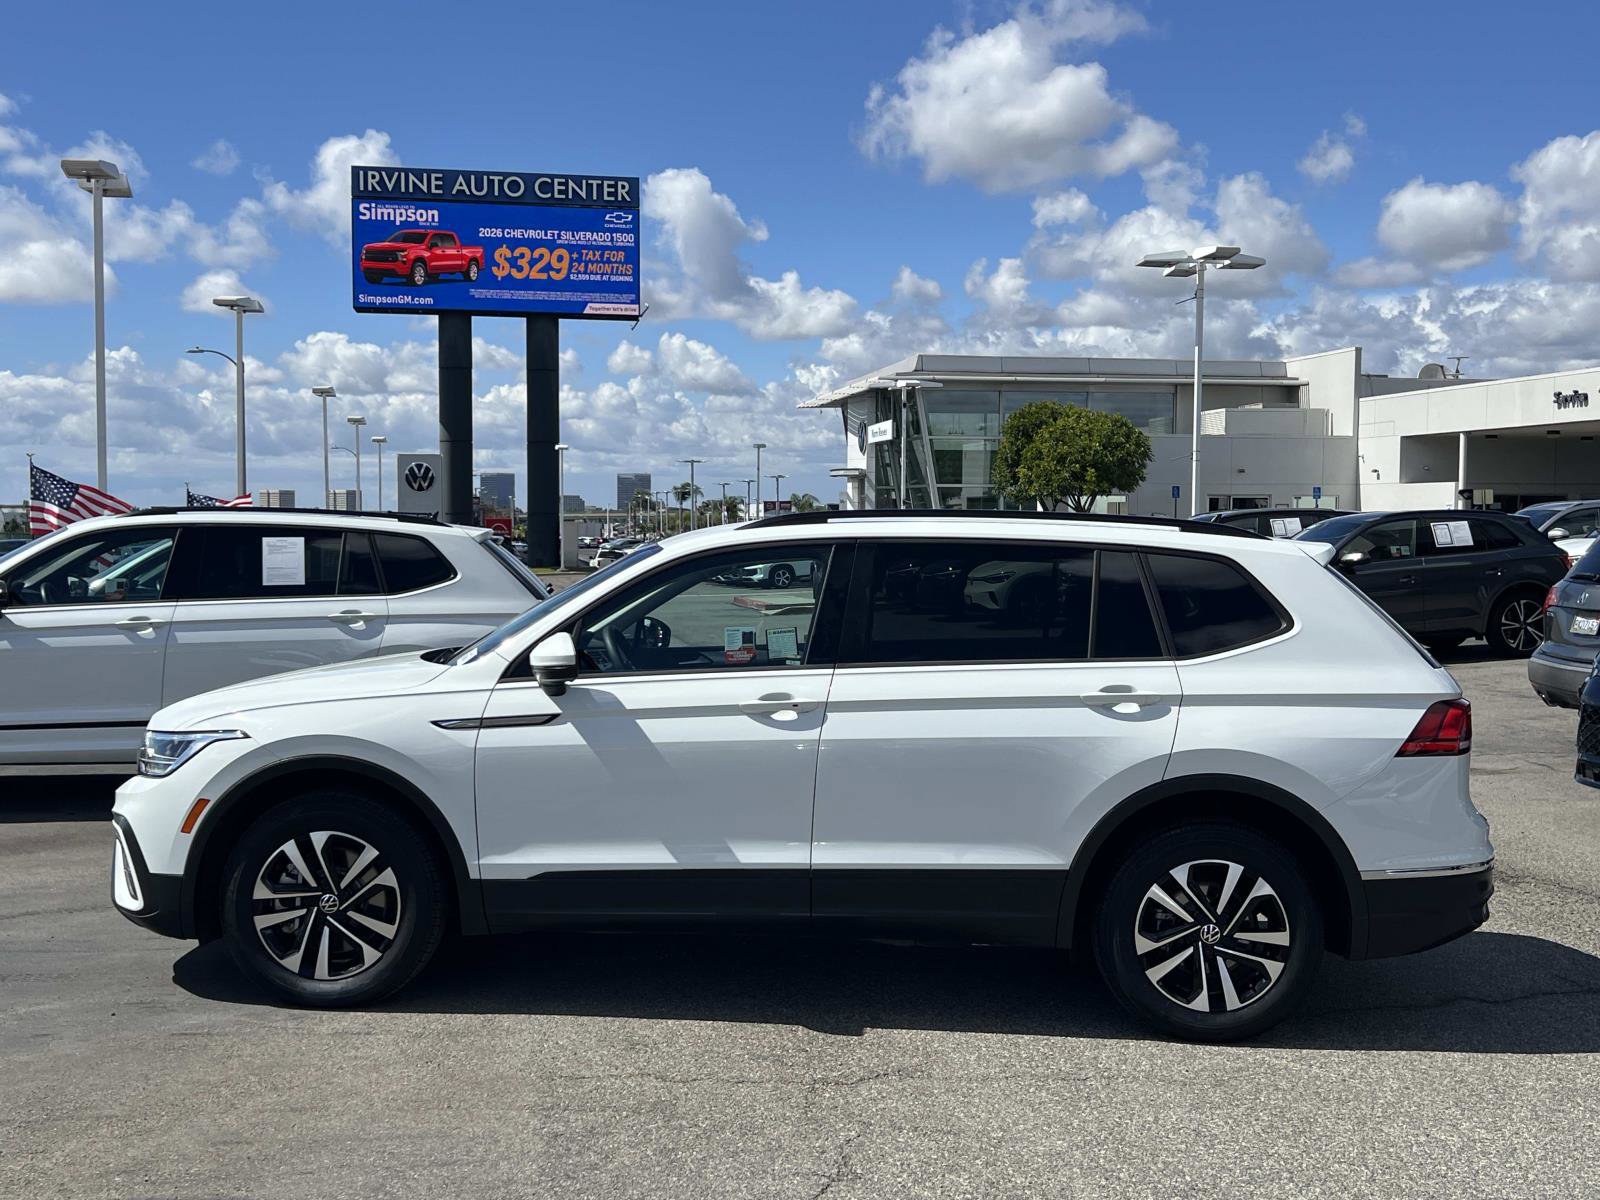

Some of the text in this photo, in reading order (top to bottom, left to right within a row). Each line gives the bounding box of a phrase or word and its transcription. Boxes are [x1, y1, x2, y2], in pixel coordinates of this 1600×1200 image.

[359, 170, 631, 201] IRVINE AUTO CENTER
[359, 203, 439, 225] Simpson
[478, 228, 503, 238] 2026
[504, 230, 559, 240] CHEVROLET
[560, 231, 611, 242] SILVERADO
[612, 233, 634, 243] 1500
[491, 244, 570, 281] $329
[571, 249, 625, 262] + TAX FOR
[571, 262, 633, 275] 24 MONTHS
[358, 294, 434, 305] SimpsonGM.com
